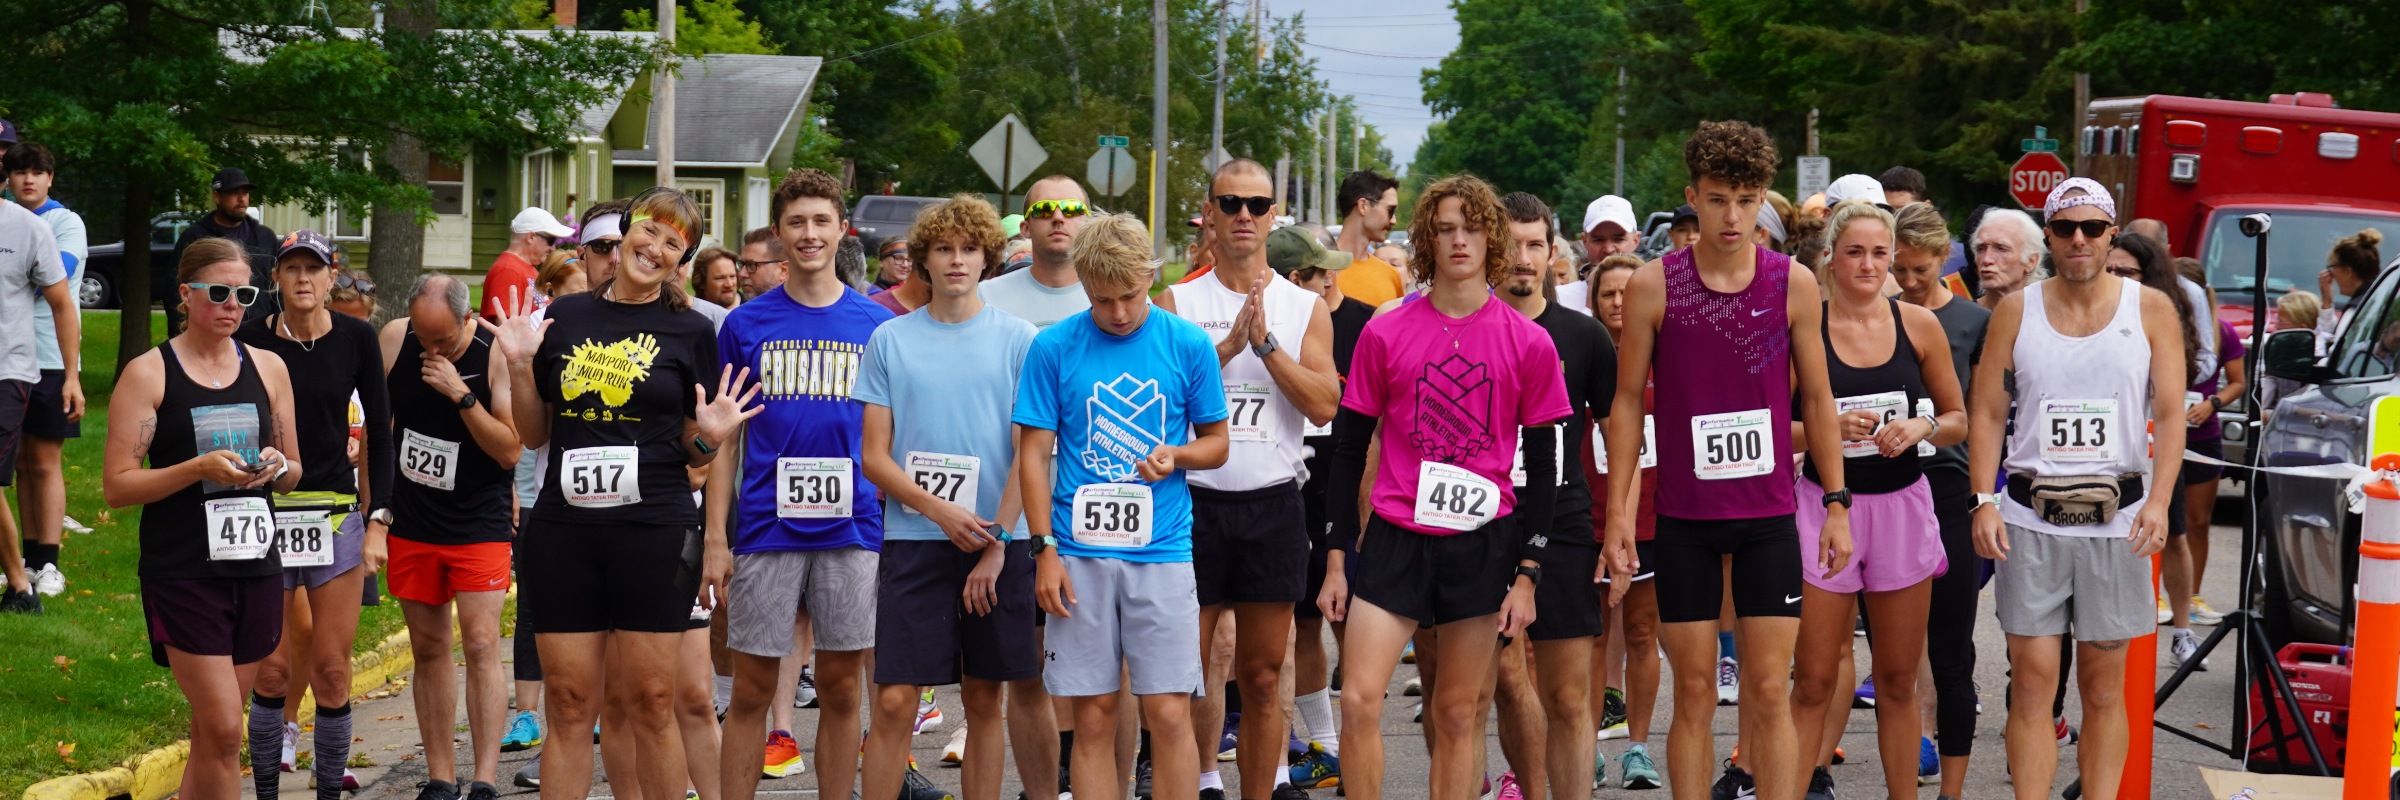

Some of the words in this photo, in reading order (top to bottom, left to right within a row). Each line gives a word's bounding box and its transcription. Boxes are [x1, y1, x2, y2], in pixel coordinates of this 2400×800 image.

[2014, 170, 2065, 192] STOP
[762, 339, 812, 350] CATHOLIC
[818, 340, 866, 353] MEMORIA
[585, 350, 633, 373] MAYPORT
[761, 350, 862, 396] CRUSADER
[579, 365, 604, 382] MUD
[604, 372, 629, 390] RUN
[1243, 383, 1260, 392] Timing
[1232, 398, 1265, 426] 77
[1423, 394, 1472, 438] HOMEGROWN
[1841, 400, 1872, 409] Performance
[2047, 404, 2080, 412] Performance
[1094, 414, 1149, 456] HOMEGROWN
[1420, 411, 1459, 446] ATHLETICS
[1700, 419, 1734, 428] Performance
[2052, 418, 2106, 447] 513
[212, 431, 248, 447] STAY
[1092, 431, 1137, 465] ATHLETICS
[1707, 430, 1761, 464] 500
[406, 446, 447, 478] 529
[570, 452, 600, 460] Performance
[785, 462, 816, 470] Performance
[912, 456, 942, 464] Performance
[573, 465, 625, 494] 517
[789, 475, 841, 504] 530
[915, 470, 965, 502] 527
[214, 502, 245, 511] Performance
[1429, 482, 1487, 517] 482
[221, 516, 267, 544] 476
[1085, 501, 1140, 532] 538
[2053, 511, 2098, 525] BROOKS
[277, 527, 322, 553] 488
